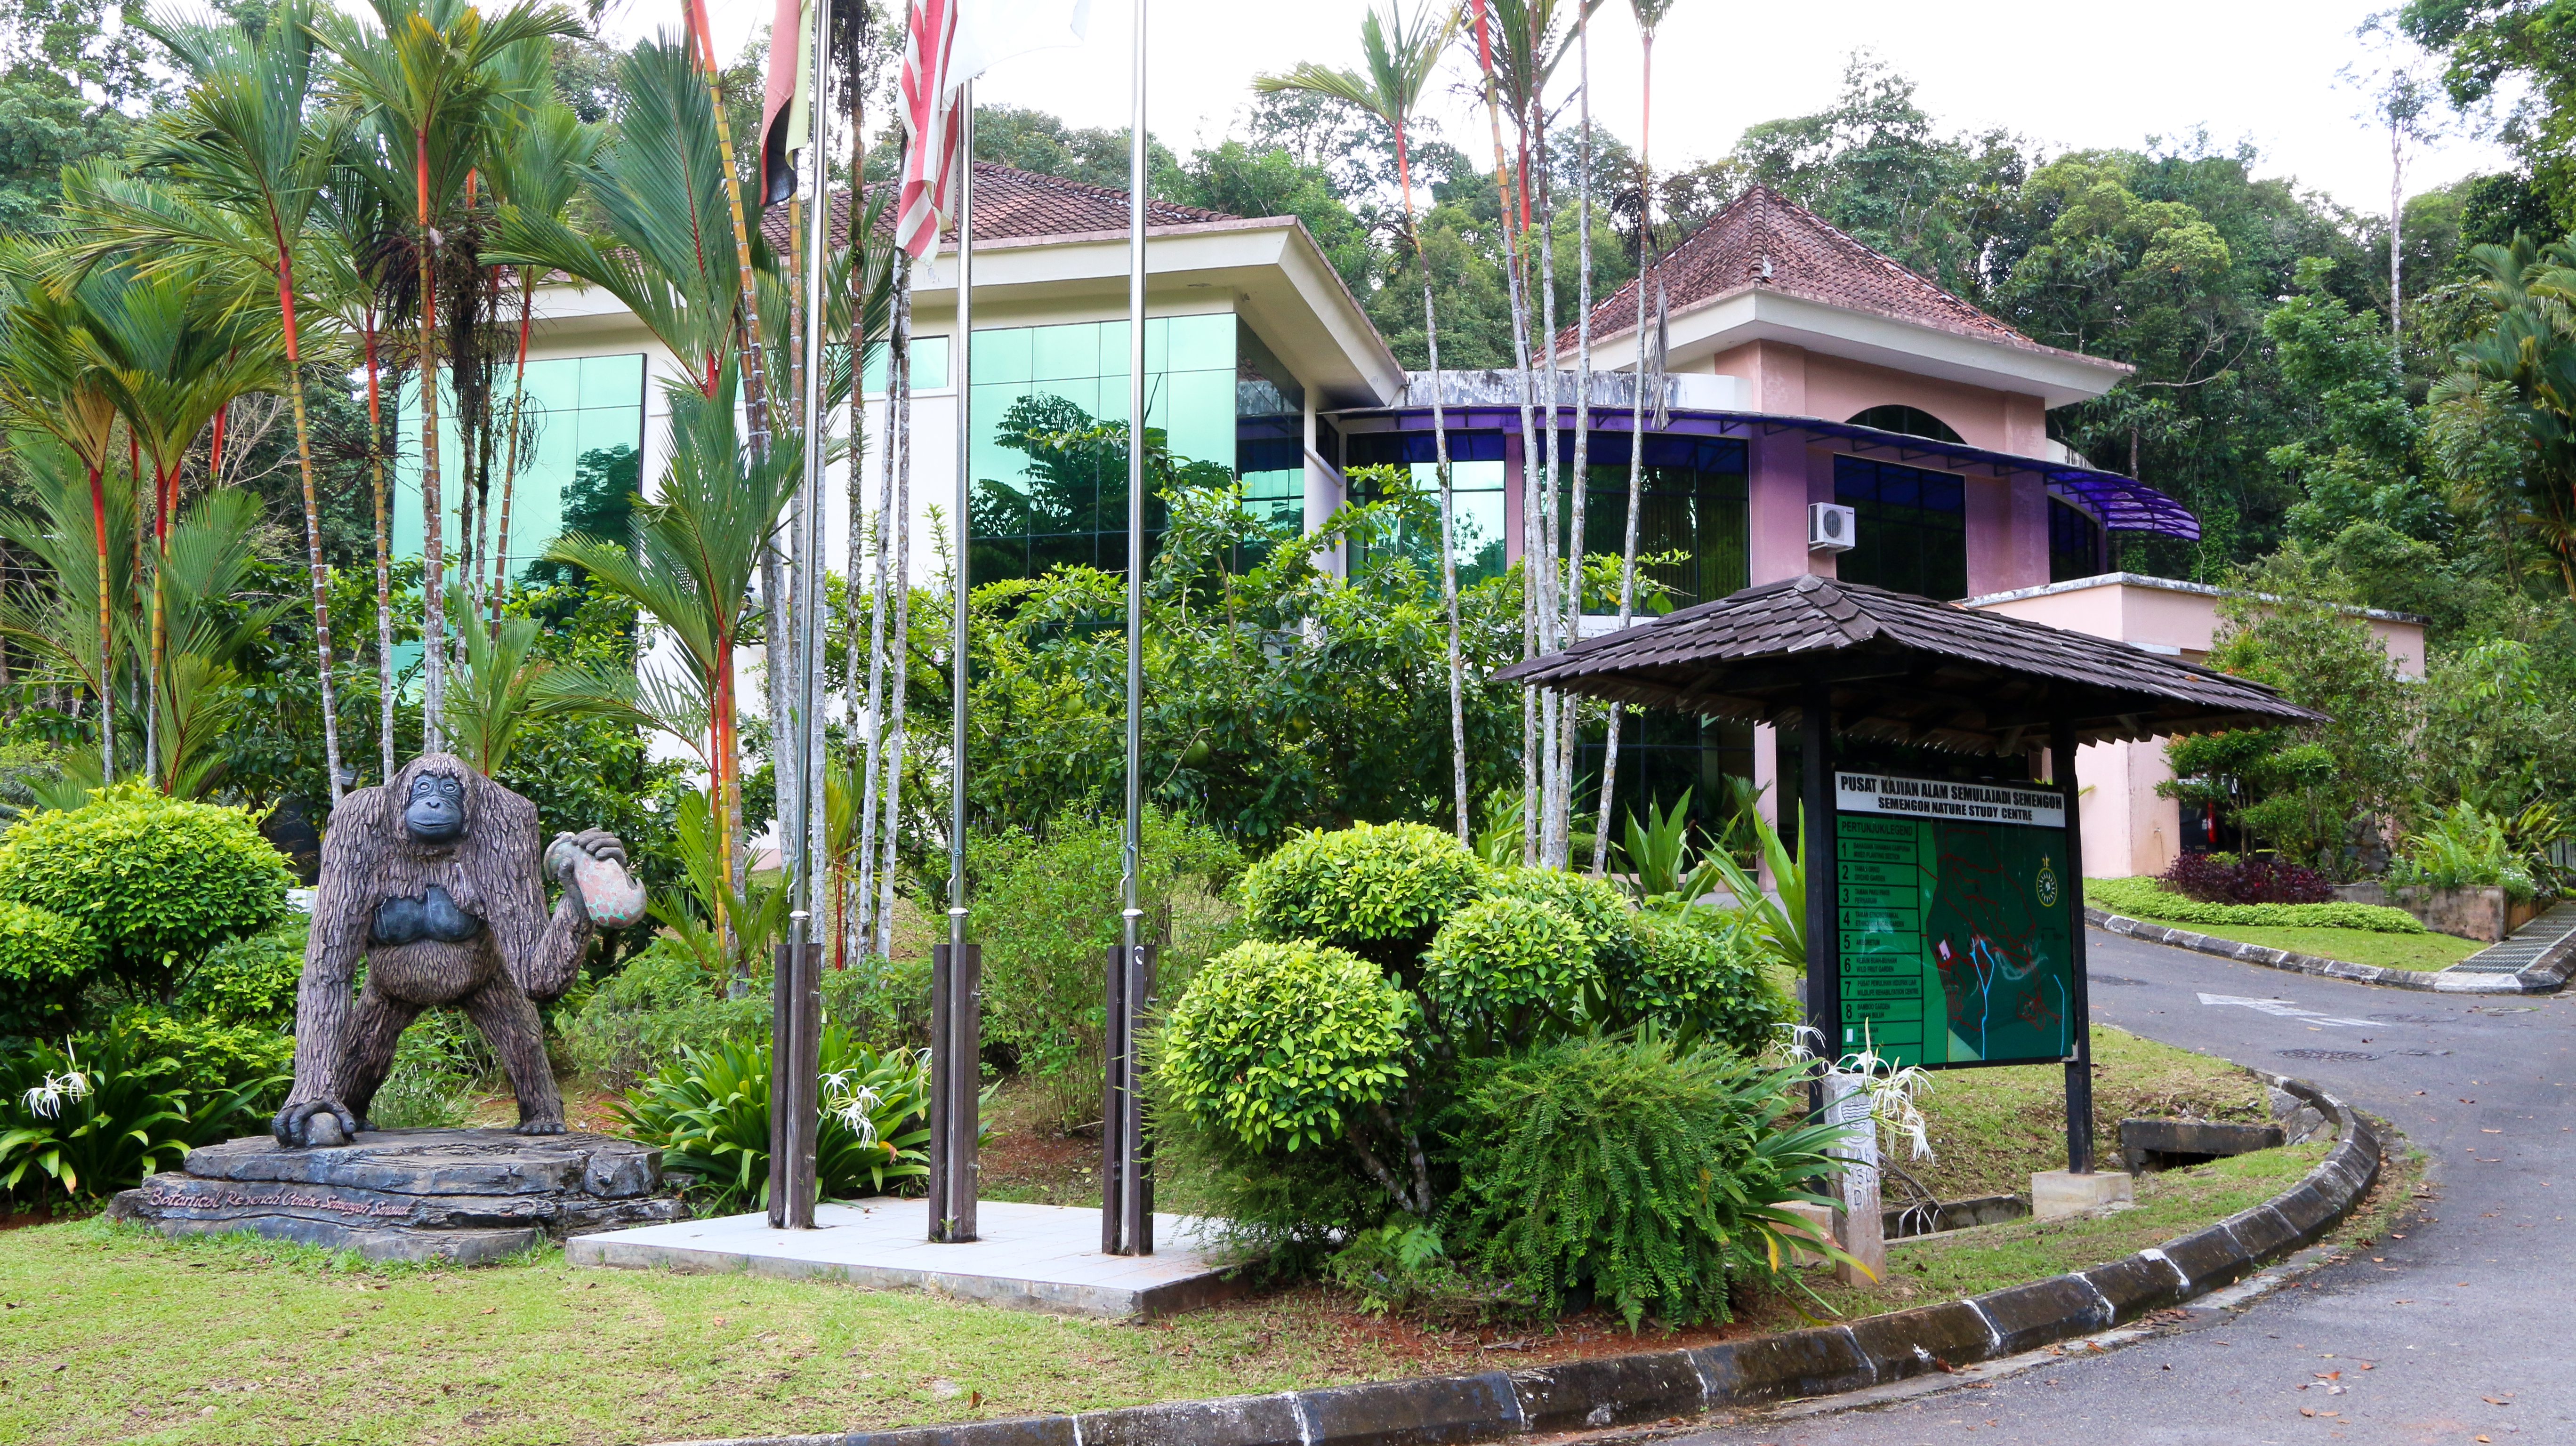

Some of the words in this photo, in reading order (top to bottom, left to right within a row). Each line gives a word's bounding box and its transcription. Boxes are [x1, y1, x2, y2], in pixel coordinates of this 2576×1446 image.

[1841, 776, 1876, 792] PUSAT
[1881, 780, 1918, 797] KAJIAN
[1921, 783, 1948, 799] ALAM
[1951, 787, 2011, 805] SEMULAJADI
[2013, 792, 2062, 809] SEMENGOH
[1879, 797, 1930, 812] SEMENGOH
[1932, 802, 1966, 815] NATURE
[1969, 804, 1998, 818] STUDY
[2002, 808, 2032, 821] CENTRE
[1842, 821, 1912, 836] PERTUNJUK/LEGEND
[1842, 842, 1846, 857] 1
[1842, 865, 1849, 880] 2
[1843, 888, 1849, 903] 3
[1843, 911, 1850, 926] 4
[1844, 934, 1851, 948] 5
[1844, 957, 1851, 972] 6
[1844, 981, 1851, 996] 7
[1846, 1004, 1852, 1019] 8
[149, 1187, 223, 1208] Botanical
[282, 1191, 321, 1208] Centre
[320, 1195, 374, 1216] Semengoh
[370, 1200, 417, 1216] Sarawak
